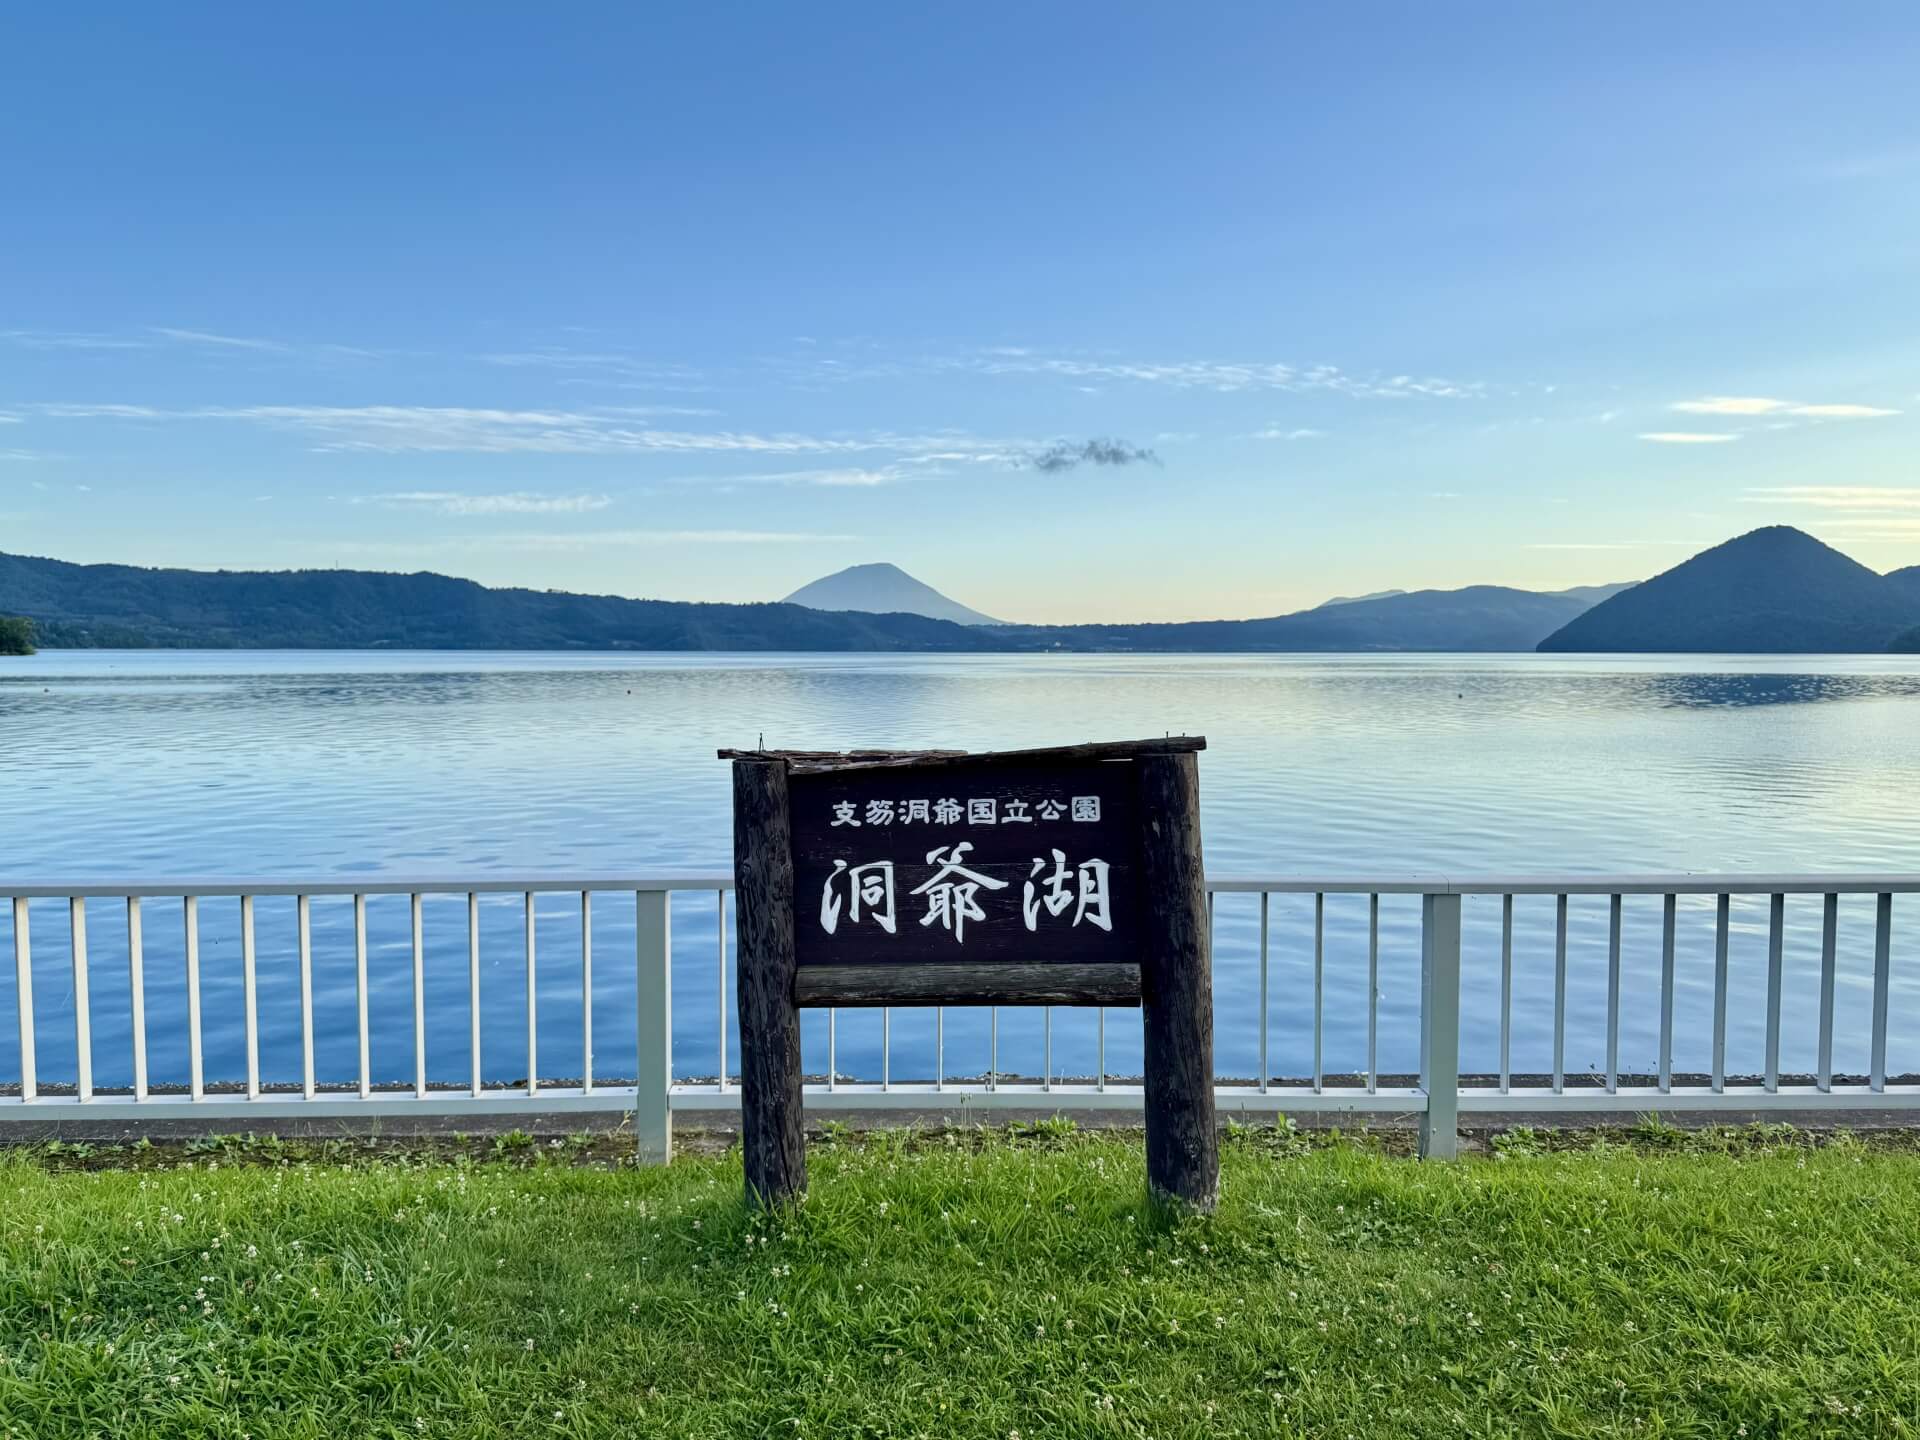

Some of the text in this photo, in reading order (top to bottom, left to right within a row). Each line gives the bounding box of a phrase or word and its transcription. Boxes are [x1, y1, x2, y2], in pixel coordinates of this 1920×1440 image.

[831, 796, 1100, 826] 支笏洞爺国立公園
[820, 842, 1112, 943] 洞爺湖
